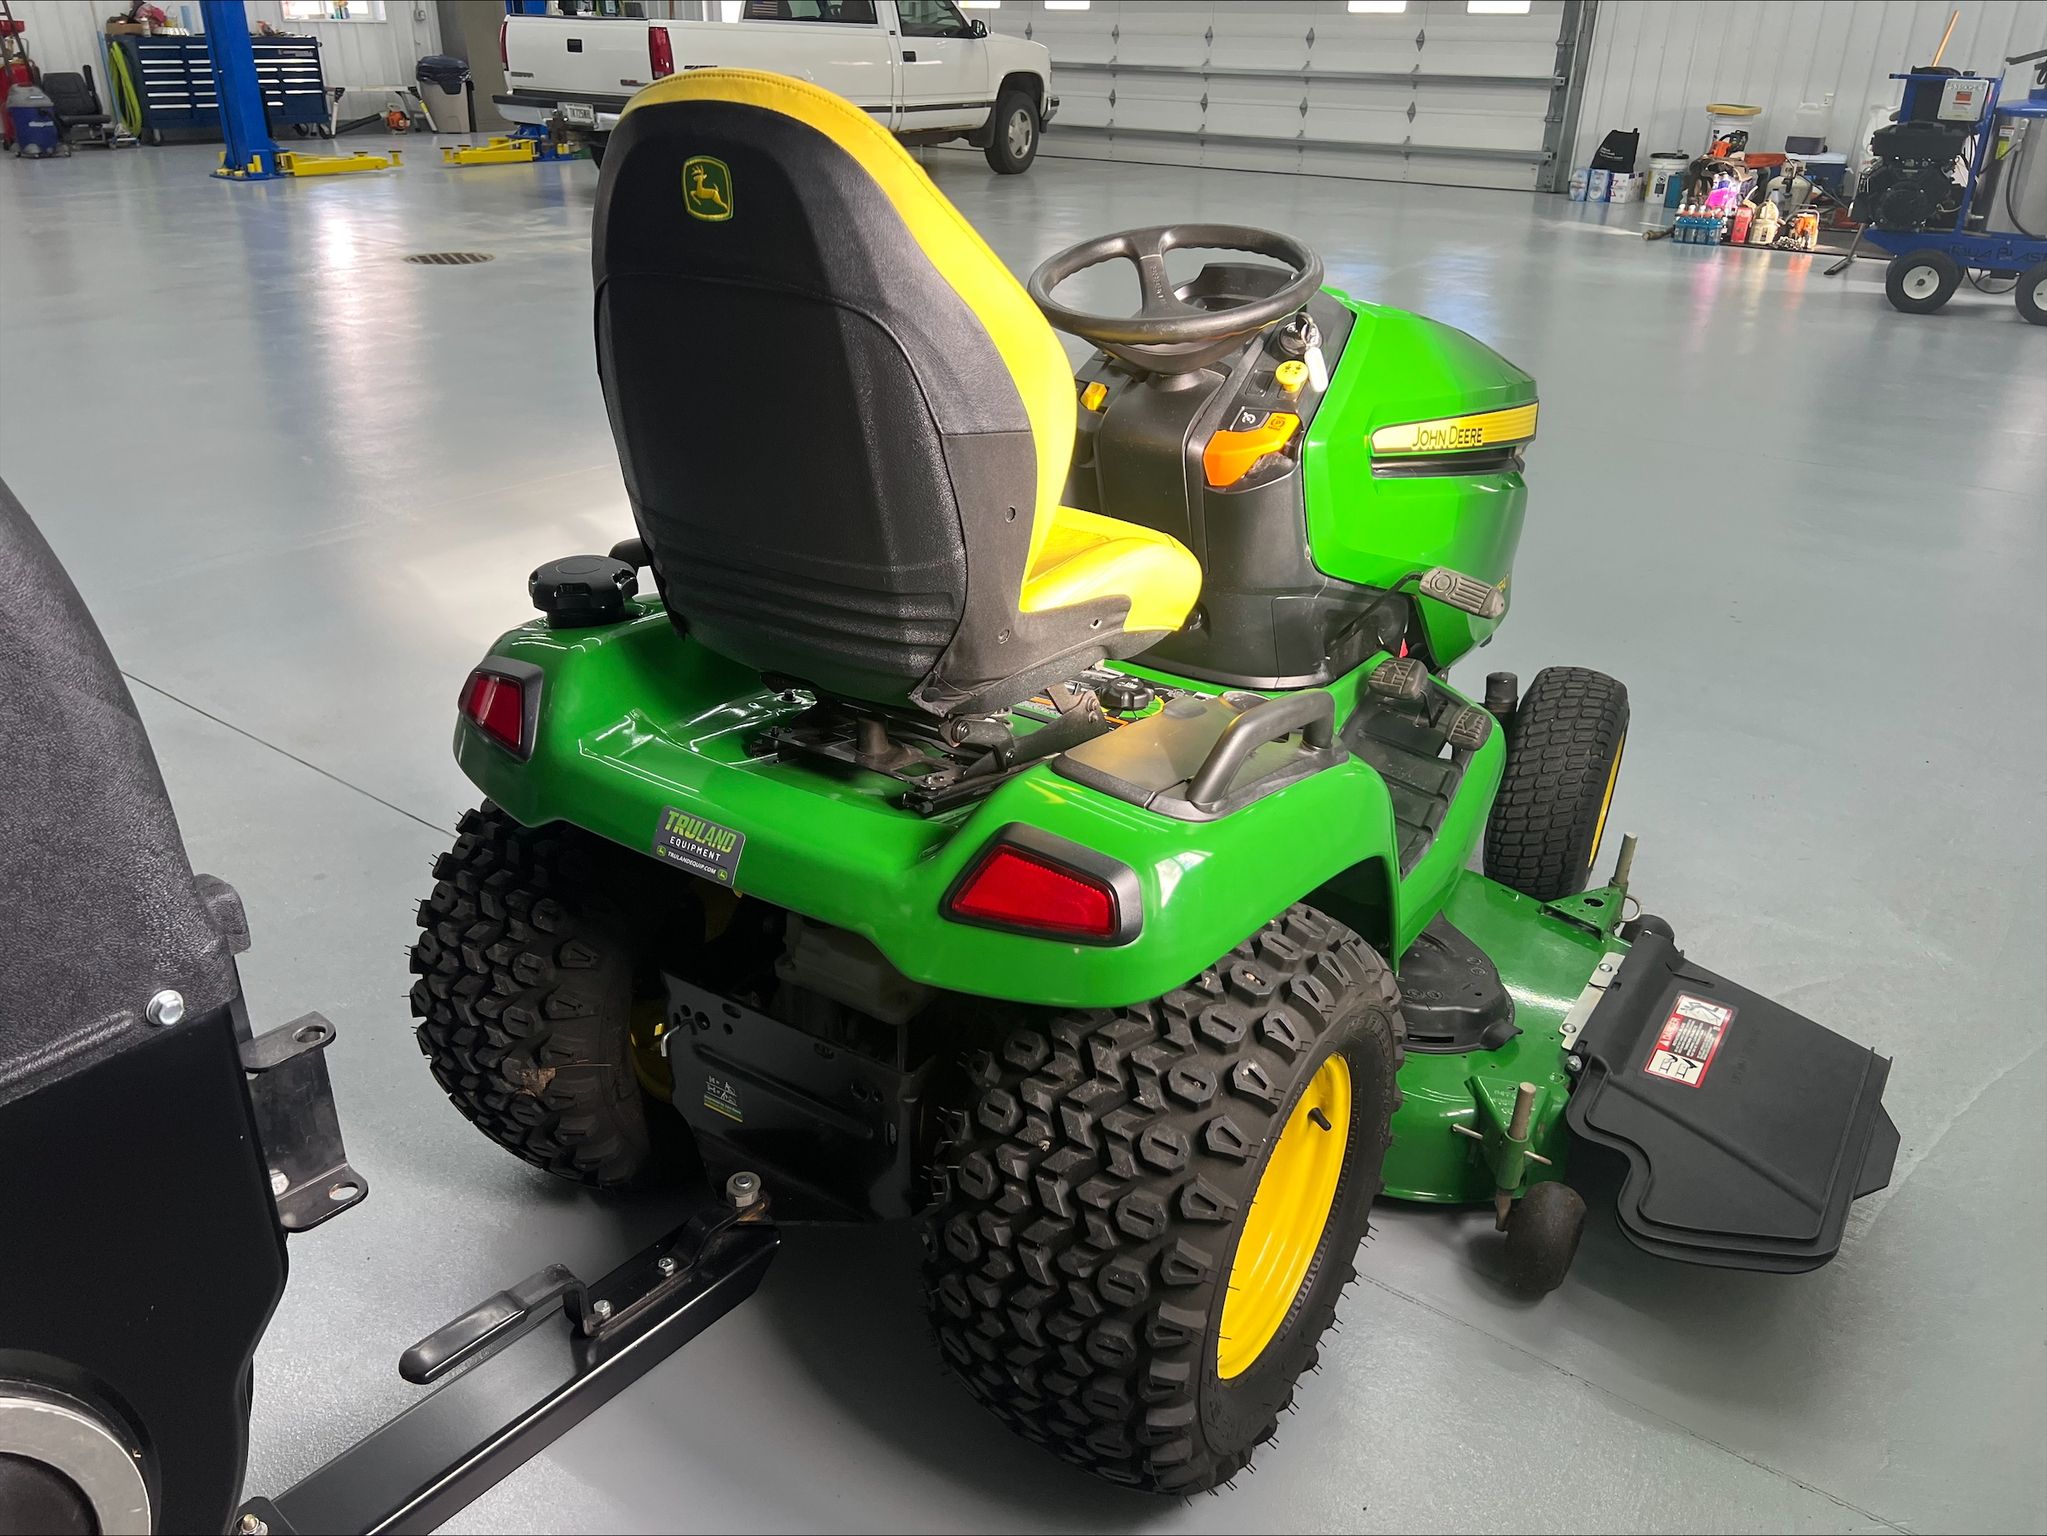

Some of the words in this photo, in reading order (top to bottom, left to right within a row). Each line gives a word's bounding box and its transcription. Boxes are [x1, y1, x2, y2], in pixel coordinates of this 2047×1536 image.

[1412, 426, 1447, 447] JOHN
[1449, 425, 1483, 445] DEERE
[665, 810, 737, 853] TRULAND
[669, 836, 721, 862] EQUIPMENT
[667, 851, 717, 875] TRULANDEQUIP.COM
[1662, 1016, 1681, 1040] DANGER
